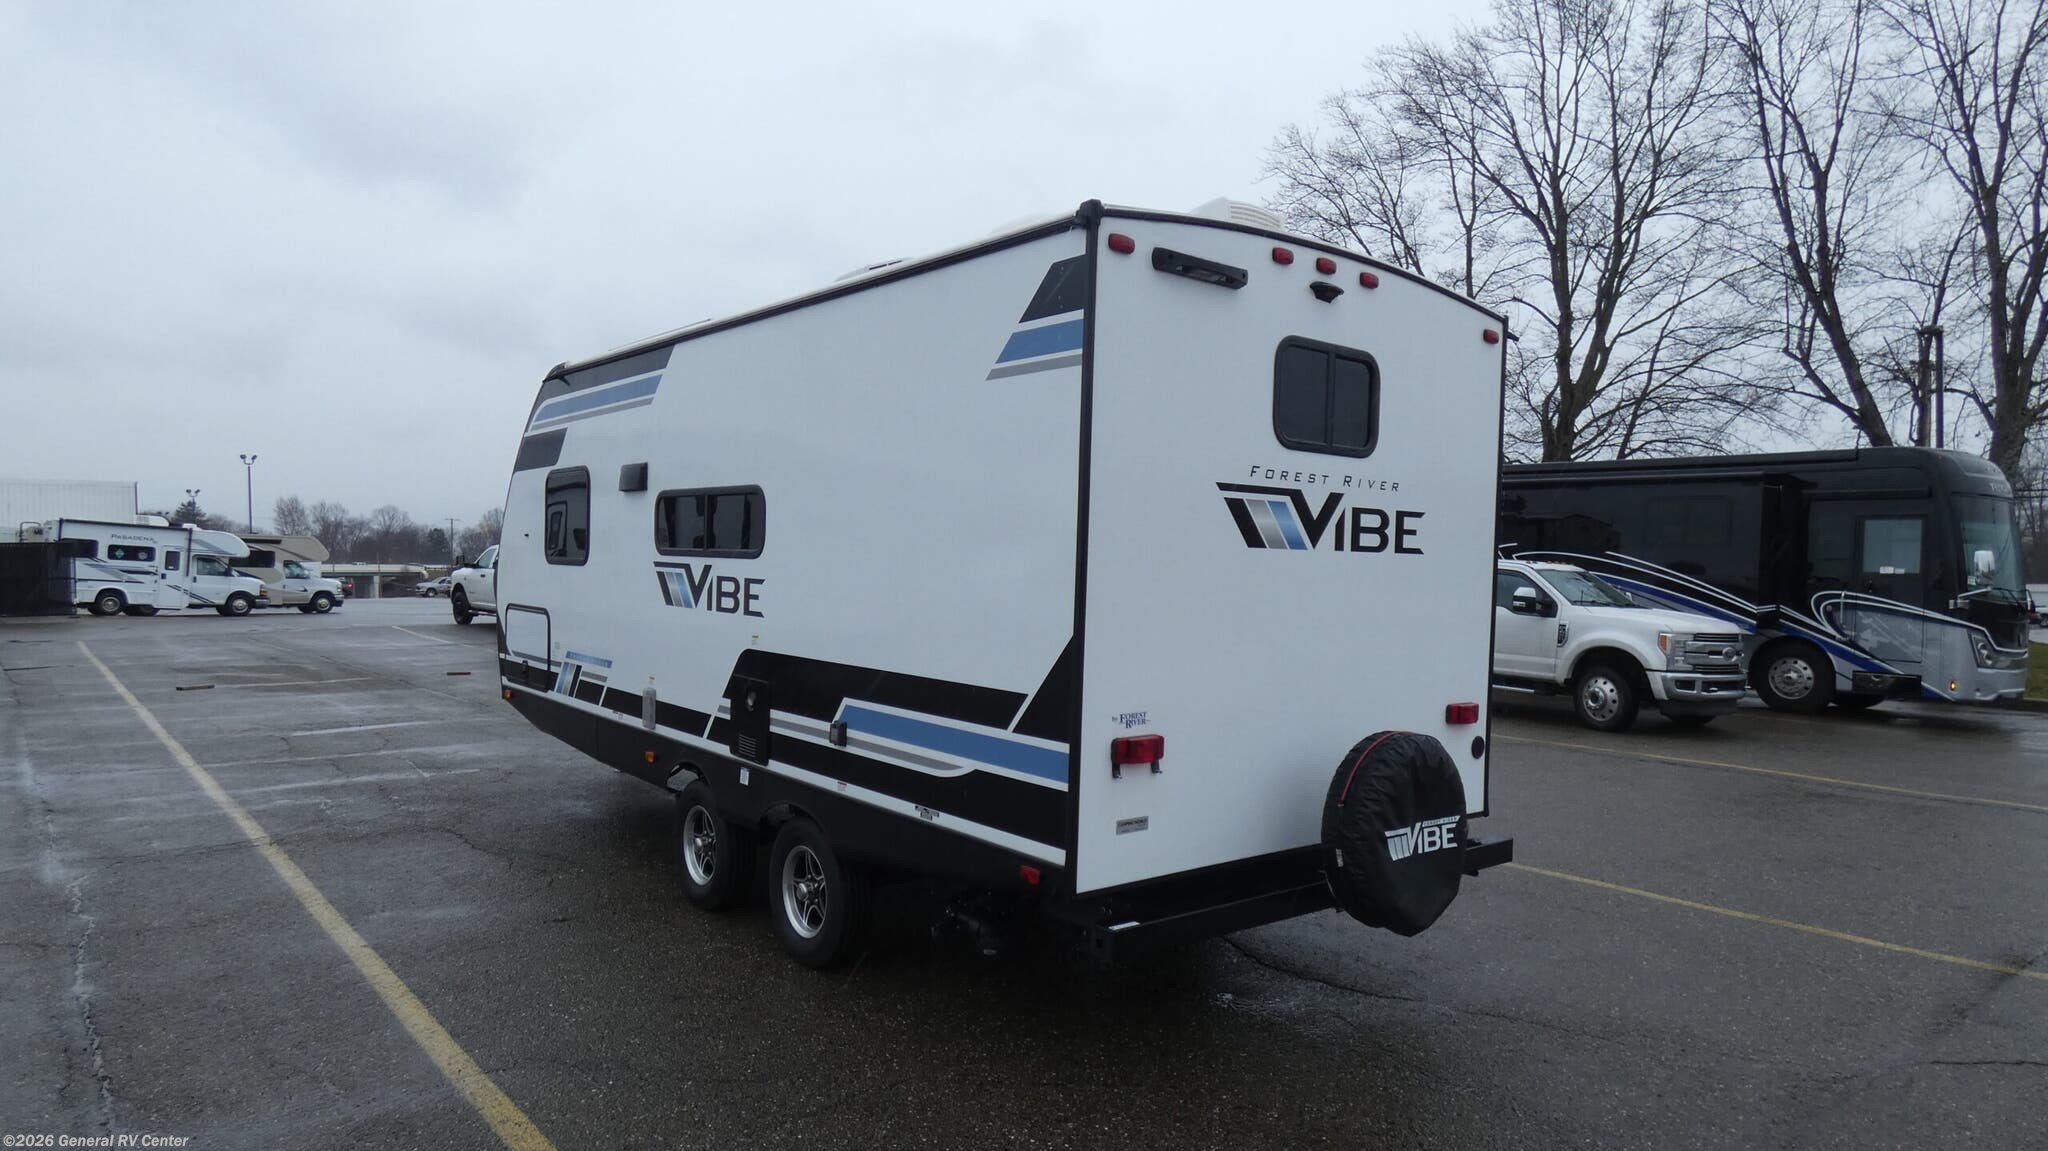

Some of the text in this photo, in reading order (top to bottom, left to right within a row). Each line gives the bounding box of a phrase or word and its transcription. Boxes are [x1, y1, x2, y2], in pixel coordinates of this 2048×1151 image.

[1250, 465, 1400, 492] FOREST RIVER
[1216, 482, 1426, 555] VIBE
[111, 534, 155, 542] PASADENA
[653, 561, 766, 618] VIBE
[1120, 712, 1147, 723] FOREST
[1126, 718, 1146, 729] RIVER
[1384, 822, 1458, 861] VIBE
